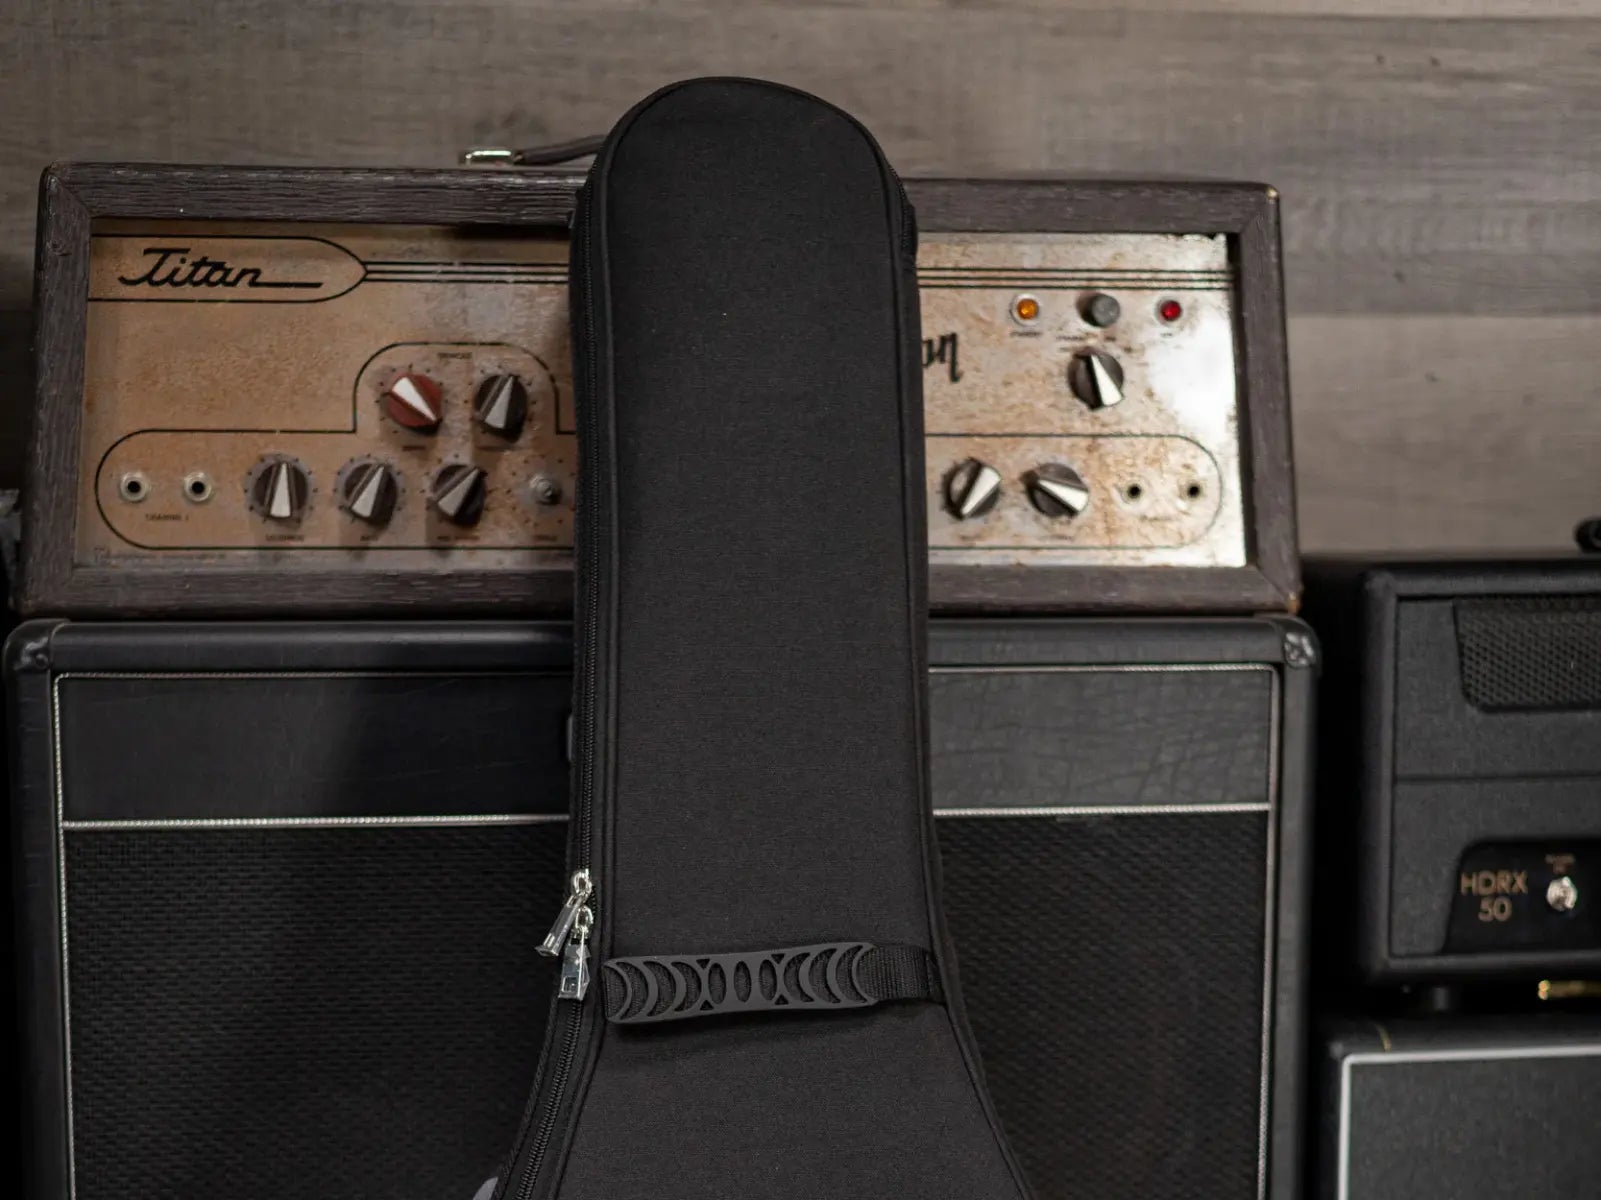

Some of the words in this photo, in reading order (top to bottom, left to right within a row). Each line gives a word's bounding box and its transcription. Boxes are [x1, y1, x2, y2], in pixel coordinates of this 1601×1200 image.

[118, 247, 323, 288] Titan
[1460, 870, 1528, 896] HDRX
[1478, 896, 1512, 922] 50
